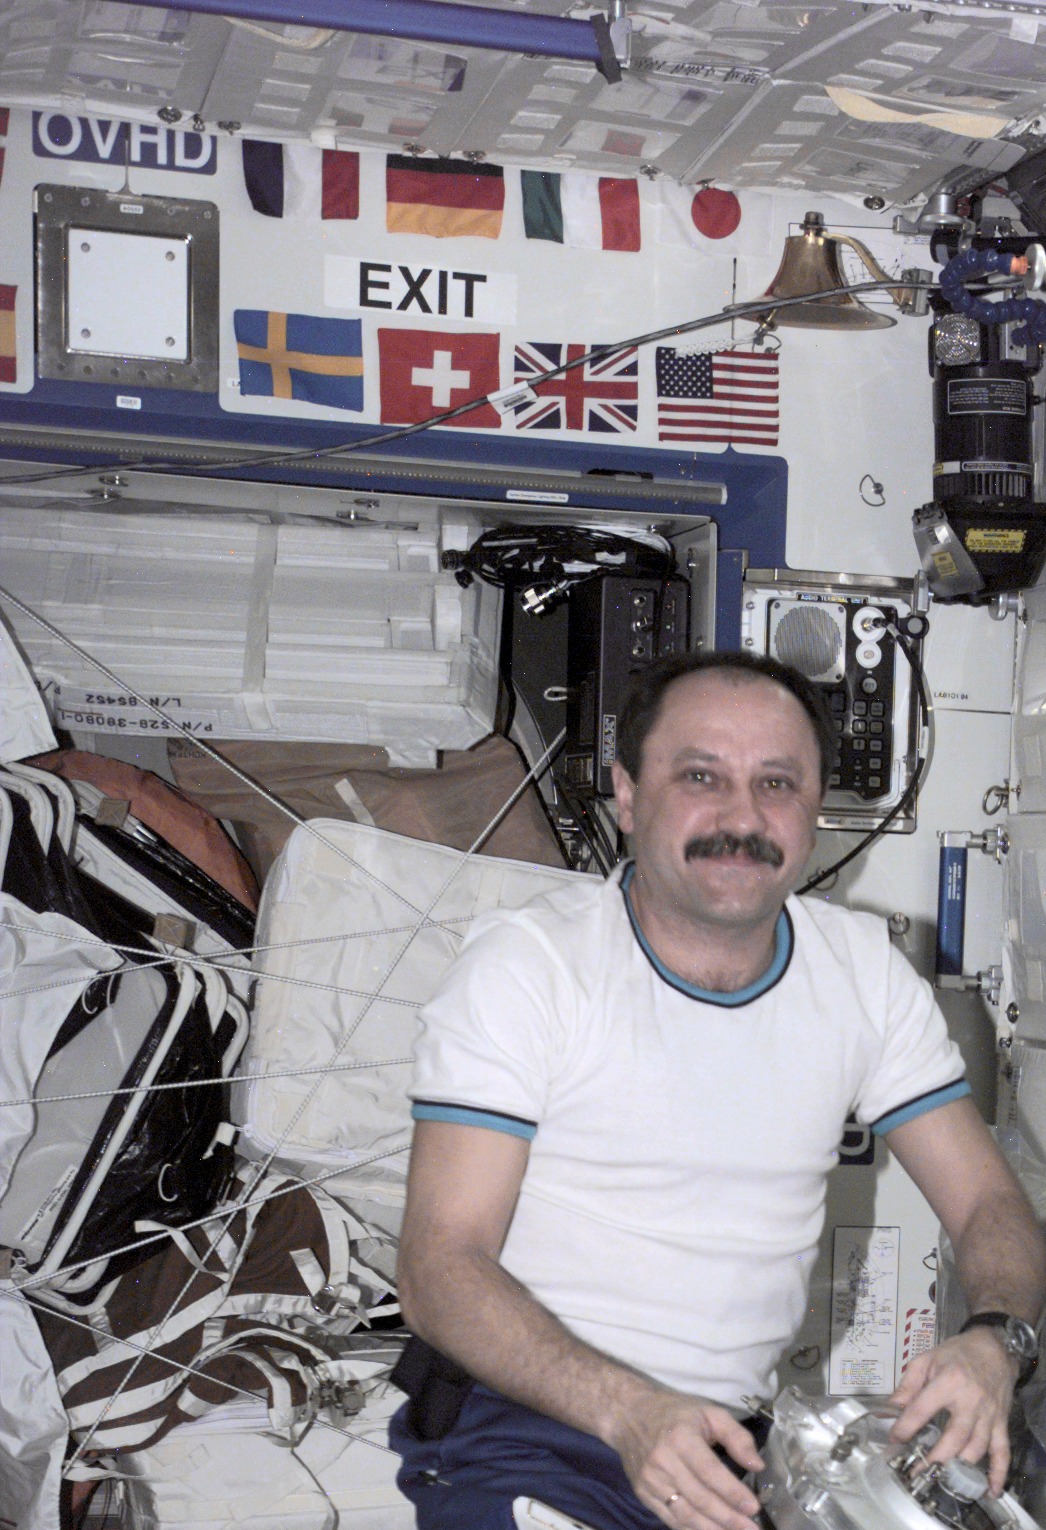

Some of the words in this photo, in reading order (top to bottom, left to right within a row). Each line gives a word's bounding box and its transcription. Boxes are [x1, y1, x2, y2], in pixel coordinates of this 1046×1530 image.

[38, 110, 213, 169] OVHD
[358, 260, 487, 319] EXIT
[149, 697, 182, 708] L/N
[181, 721, 213, 733] P/N
